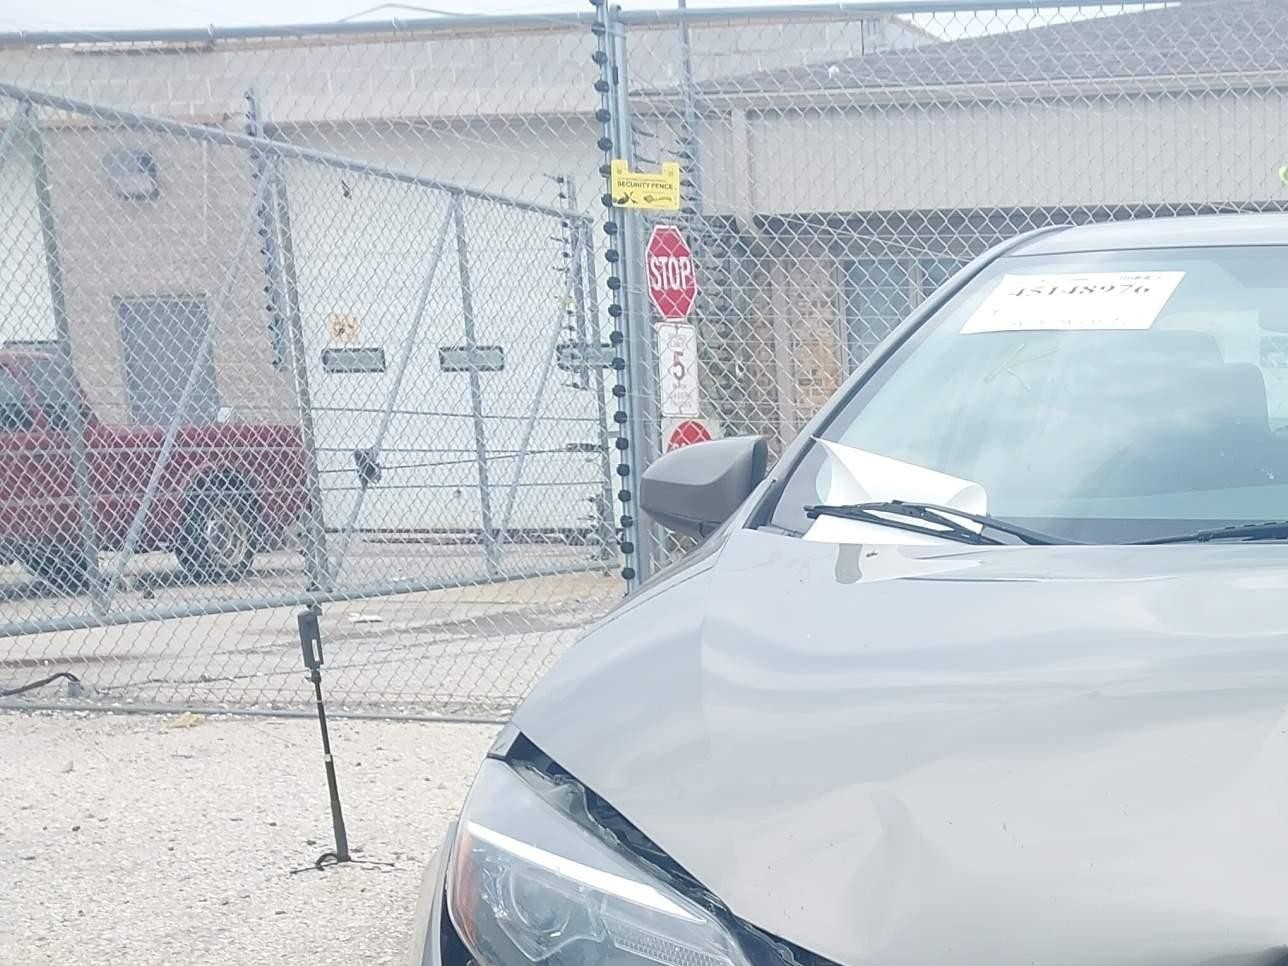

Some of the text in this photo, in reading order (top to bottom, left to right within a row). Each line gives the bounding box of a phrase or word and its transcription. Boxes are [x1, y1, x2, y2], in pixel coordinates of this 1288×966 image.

[617, 180, 650, 189] SECURITY
[651, 182, 673, 190] FENCE
[648, 256, 692, 291] STOP
[672, 351, 686, 381] 5
